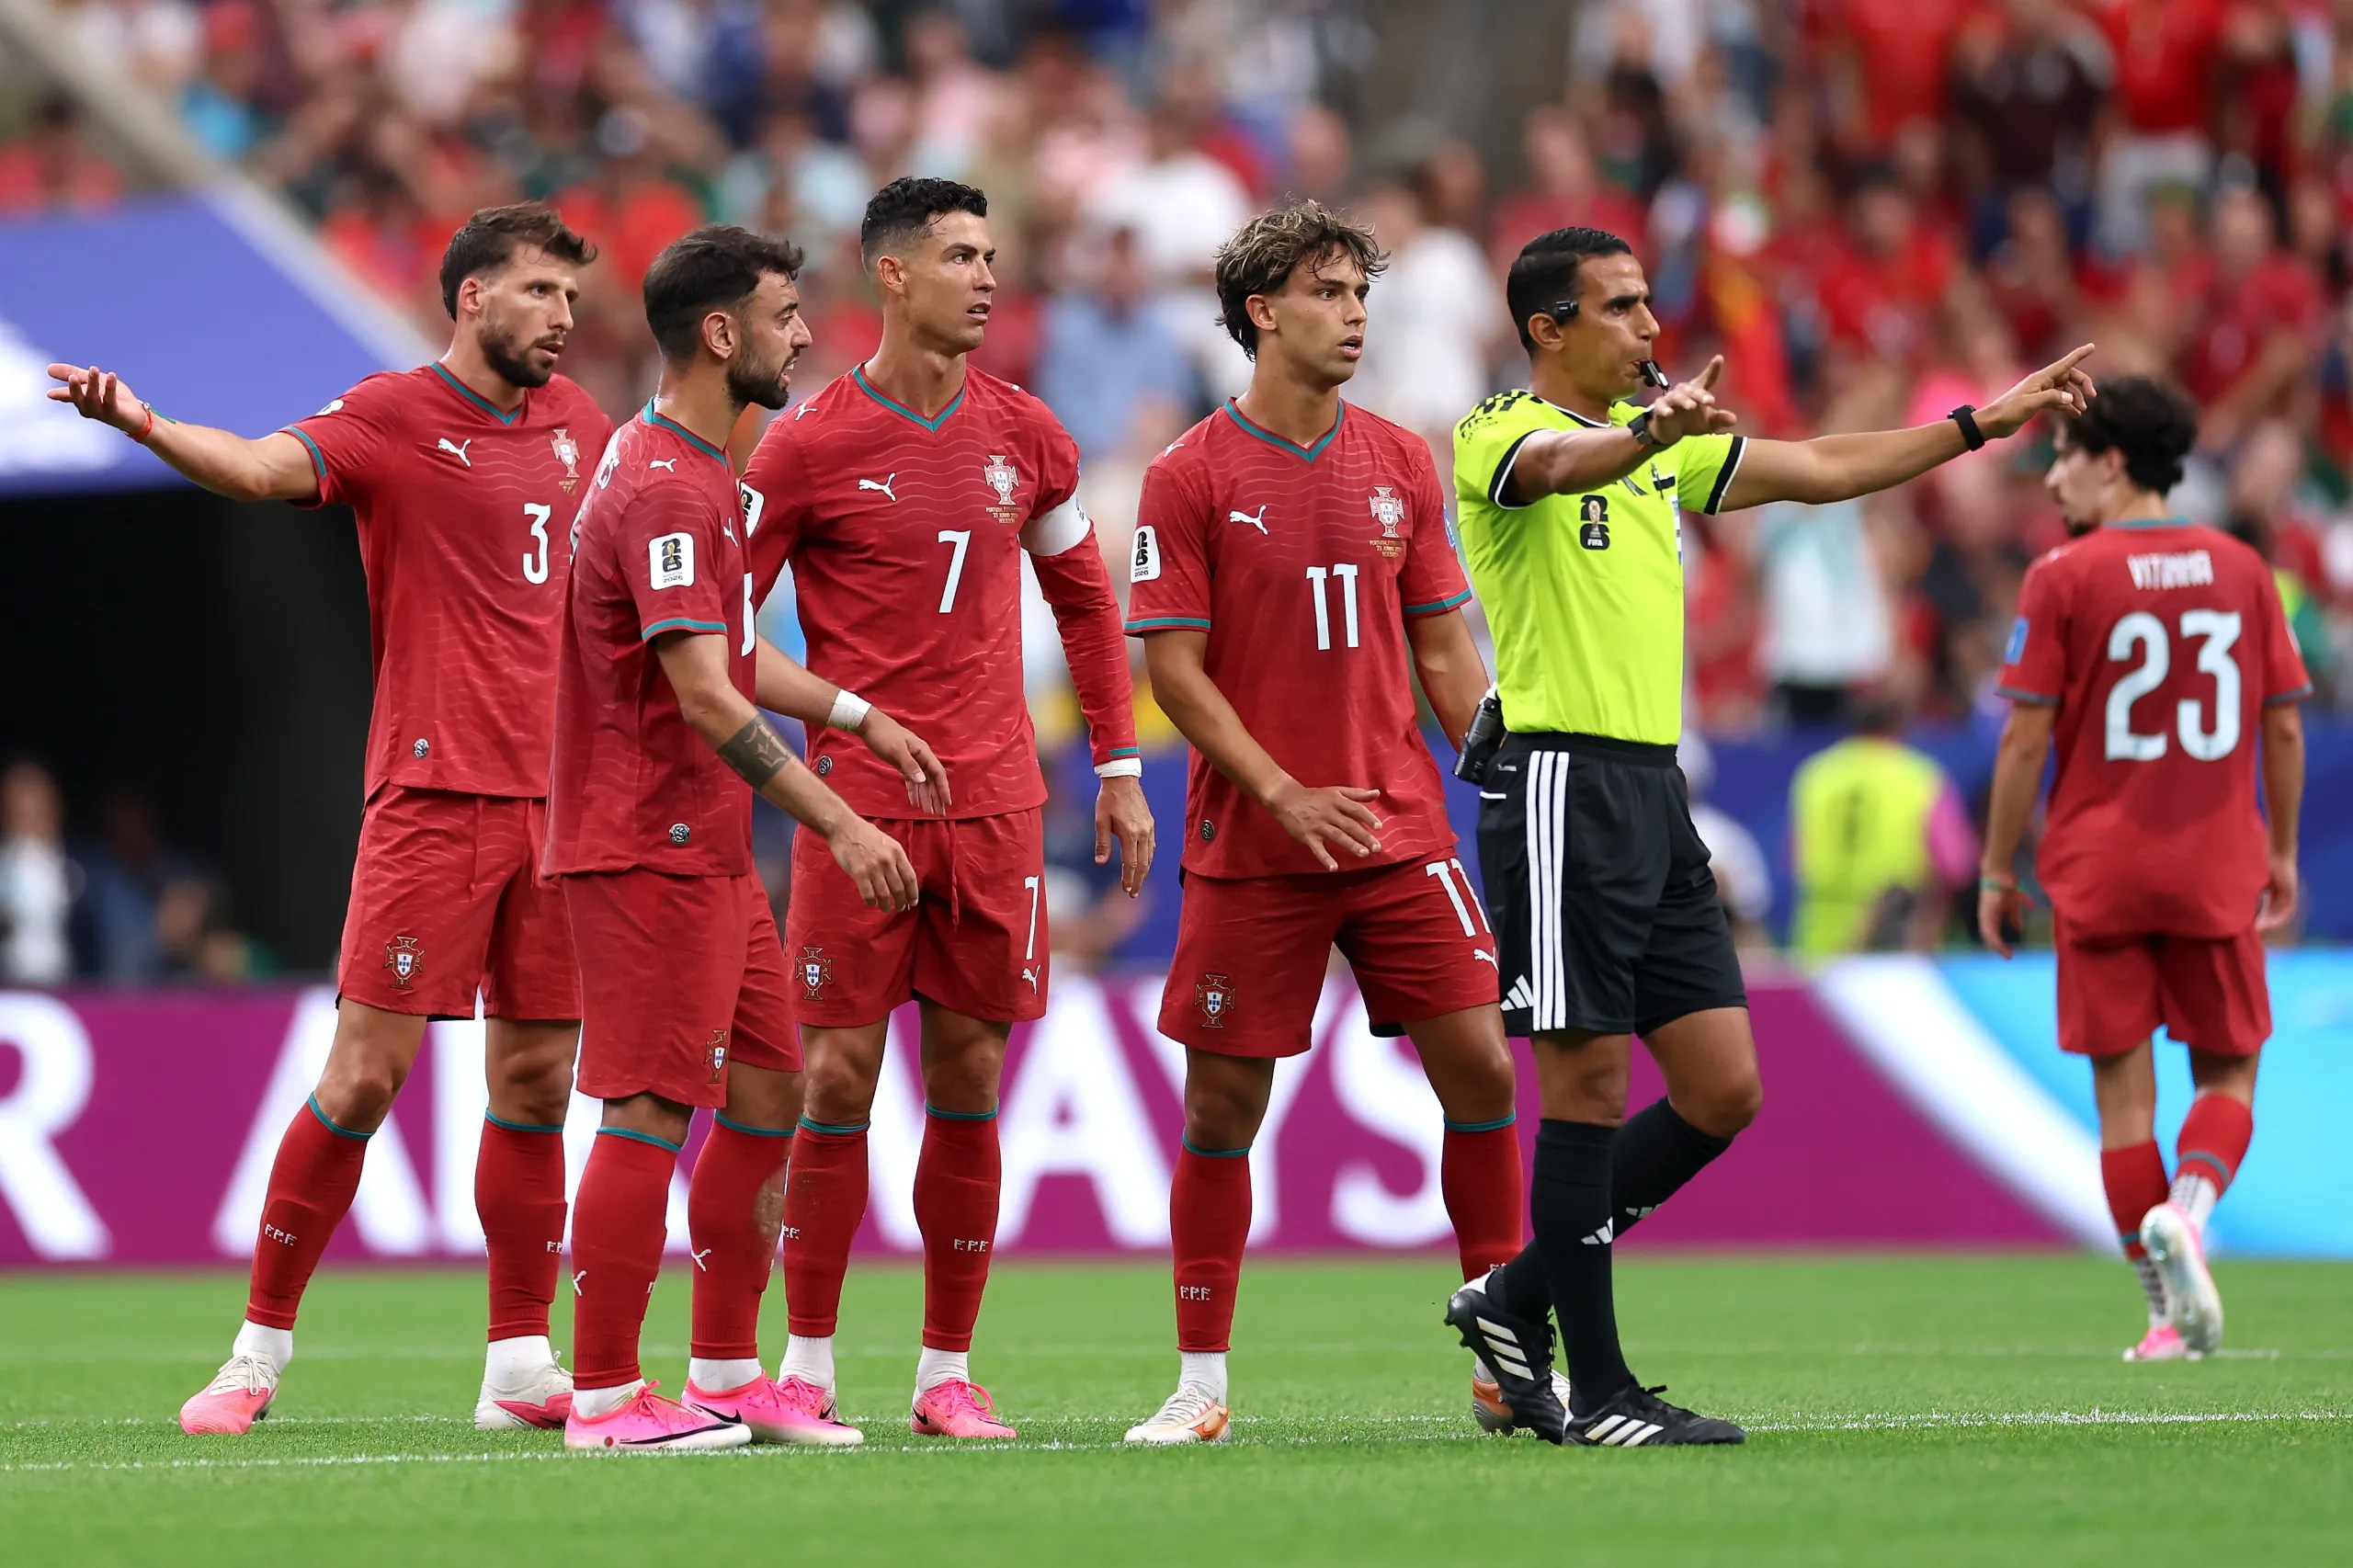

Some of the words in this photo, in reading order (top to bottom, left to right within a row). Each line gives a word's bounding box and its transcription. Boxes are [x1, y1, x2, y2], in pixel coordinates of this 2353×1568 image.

[522, 502, 551, 585] 3
[663, 575, 684, 584] 2026
[938, 528, 972, 613] 7
[1586, 538, 1603, 547] FIFA
[1305, 562, 1359, 651] 11
[2105, 609, 2242, 763] 23
[1024, 874, 1040, 960] 7
[211, 982, 1452, 1260] AIAYS
